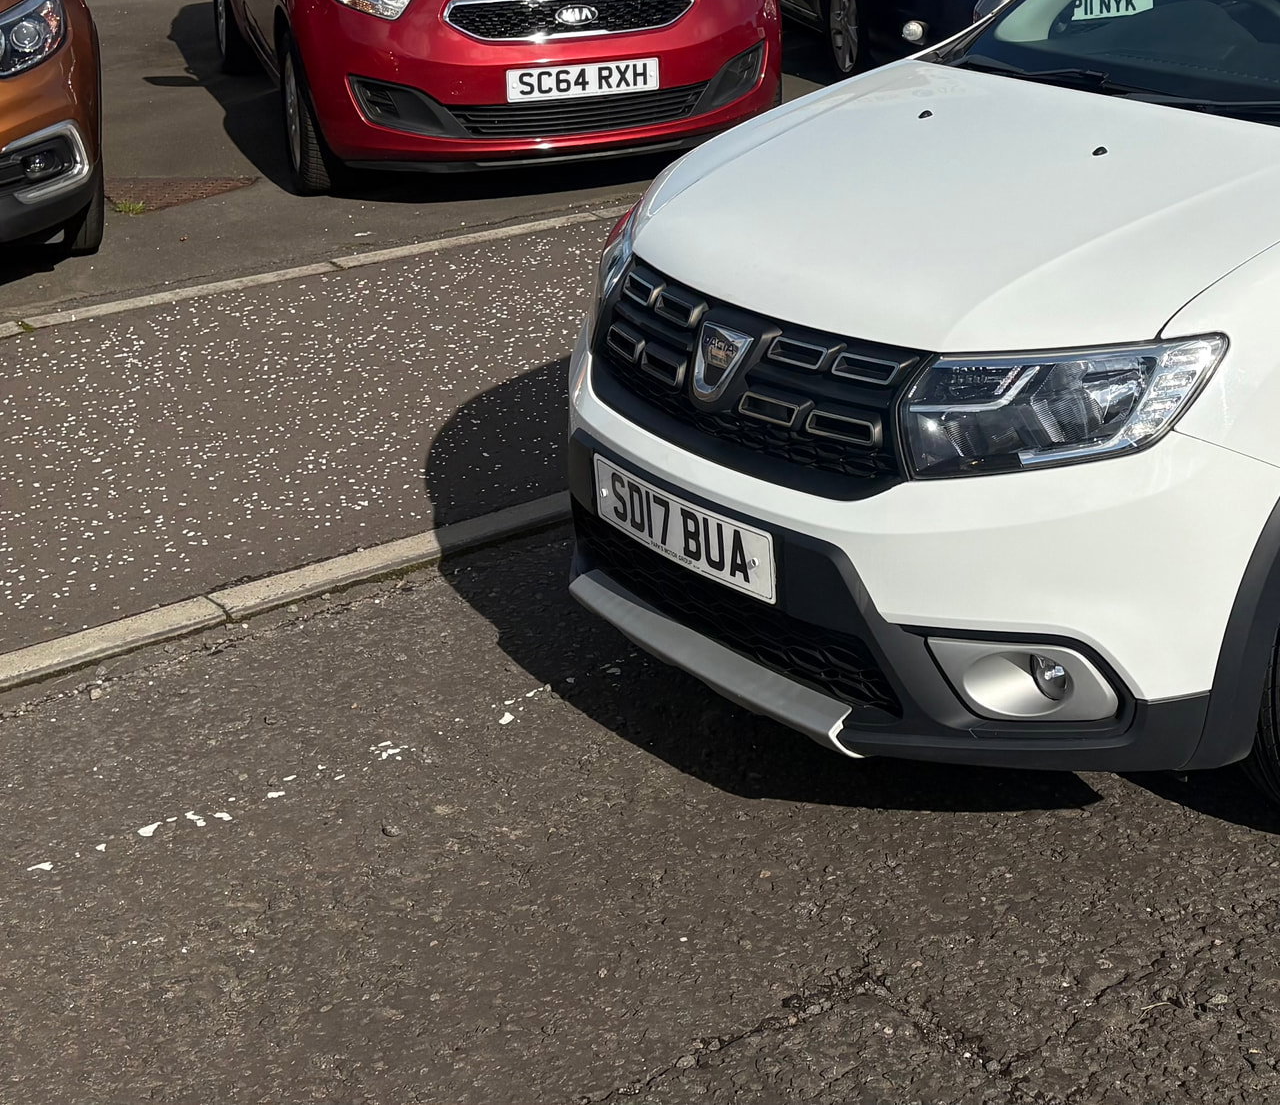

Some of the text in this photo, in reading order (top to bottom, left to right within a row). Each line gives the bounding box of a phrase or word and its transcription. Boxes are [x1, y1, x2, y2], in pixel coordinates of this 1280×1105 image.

[560, 7, 593, 23] KIA
[518, 62, 648, 95] SC64 RXH
[611, 472, 750, 584] SD17 BUA
